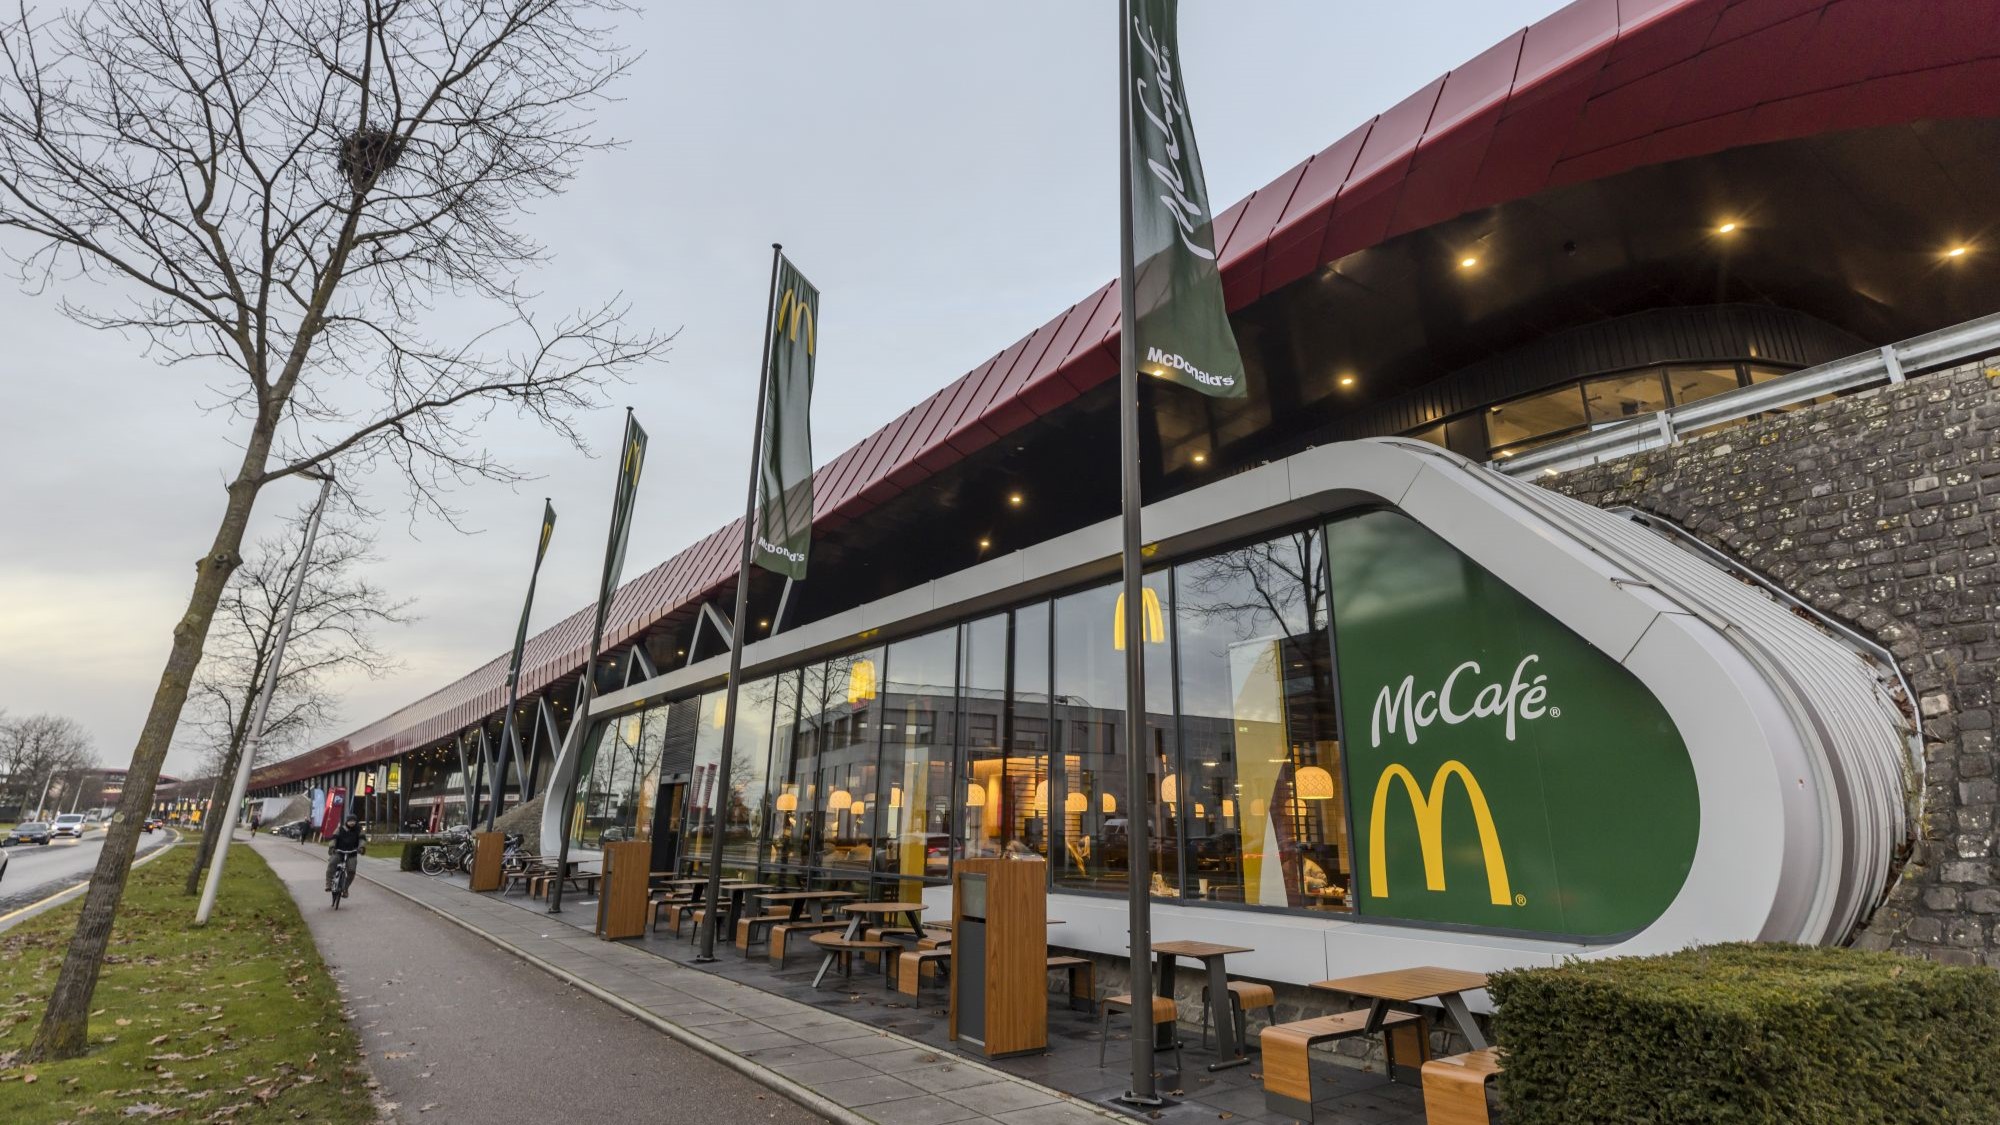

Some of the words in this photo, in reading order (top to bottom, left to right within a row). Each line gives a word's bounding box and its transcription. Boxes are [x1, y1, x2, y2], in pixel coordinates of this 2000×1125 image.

[1147, 347, 1235, 386] McDonald's
[758, 536, 805, 562] McDond's
[1371, 654, 1548, 748] McCafé
[1369, 760, 1512, 906] M
